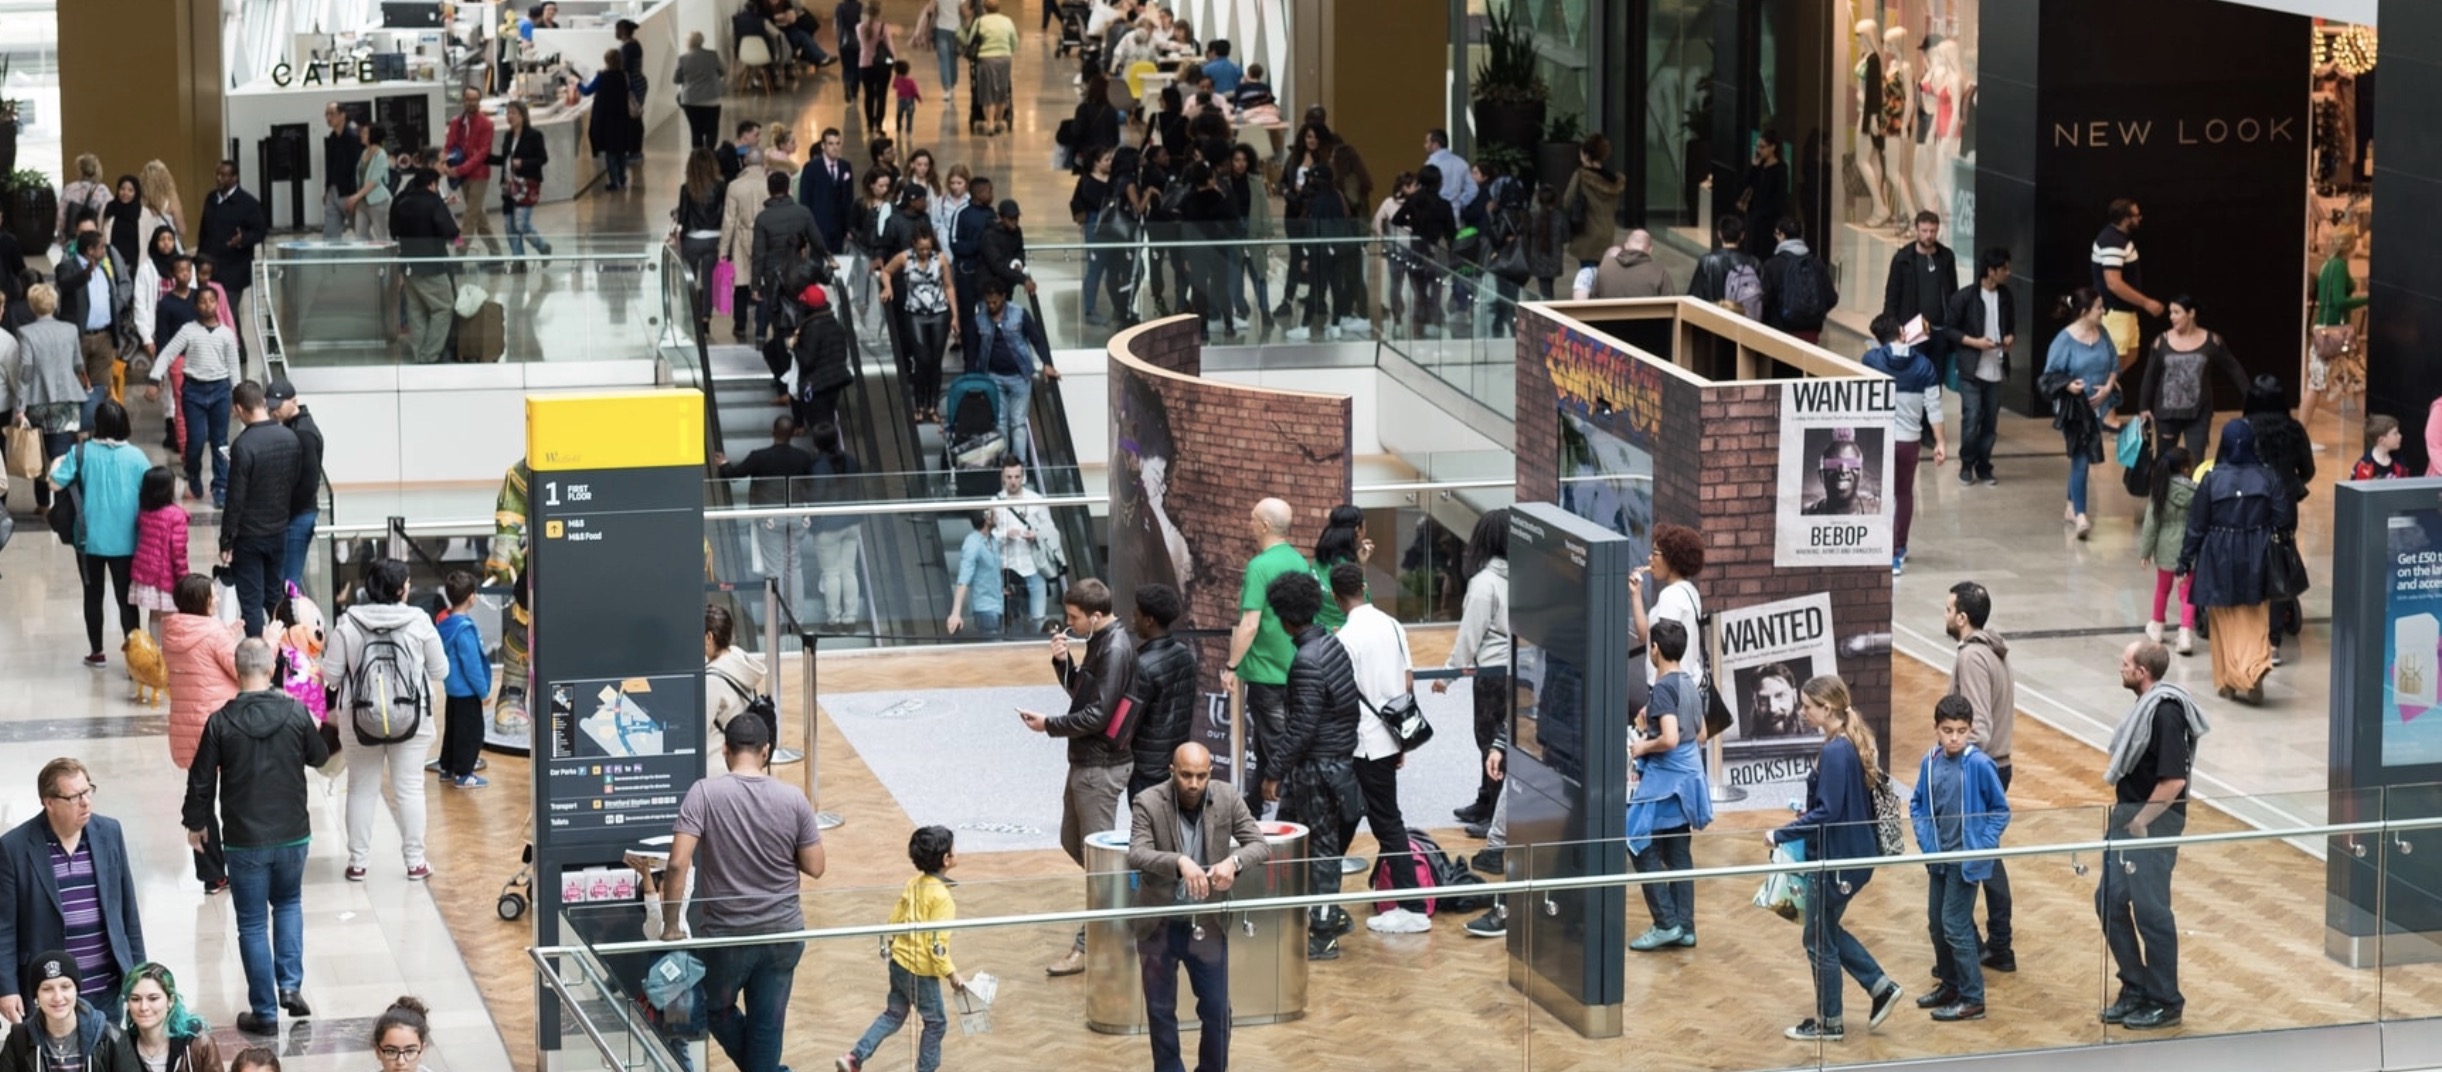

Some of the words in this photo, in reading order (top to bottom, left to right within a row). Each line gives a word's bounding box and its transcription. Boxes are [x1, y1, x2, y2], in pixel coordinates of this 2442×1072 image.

[2055, 120, 2152, 147] NEW
[2178, 117, 2294, 144] LOOK
[1793, 379, 1896, 413] WANTED
[545, 481, 561, 506] 1
[567, 492, 592, 501] FLOOR
[585, 531, 603, 540] Food
[1810, 525, 1869, 547] BEBOP
[2397, 553, 2417, 564] Get
[2418, 551, 2436, 563] £50
[2397, 568, 2411, 577] on
[2413, 564, 2430, 576] the
[2397, 578, 2417, 590] and
[1720, 606, 1824, 656] WANTED
[1206, 730, 1226, 740] OUT
[550, 801, 578, 812] Transport
[550, 818, 570, 827] Toilets
